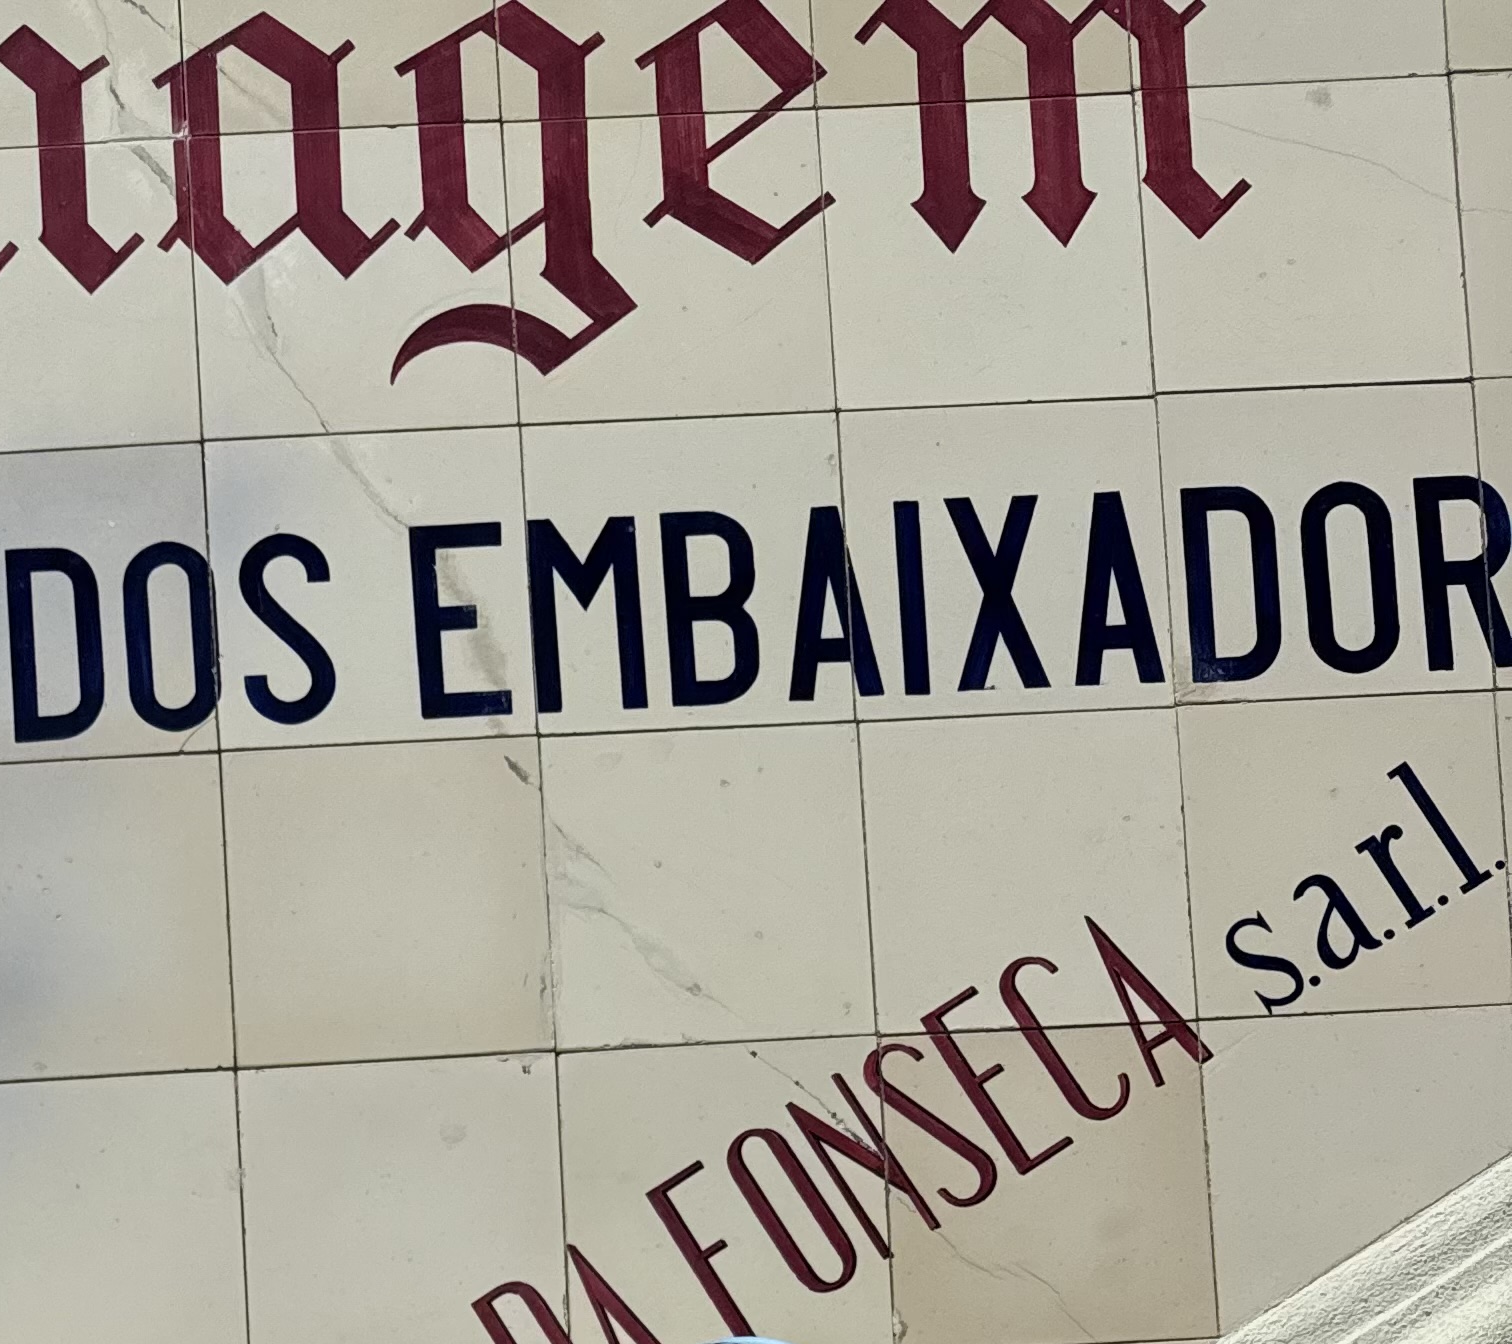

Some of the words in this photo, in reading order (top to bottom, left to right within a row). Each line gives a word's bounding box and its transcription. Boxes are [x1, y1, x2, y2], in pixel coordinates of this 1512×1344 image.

[4, 531, 336, 743] DOS
[408, 474, 1512, 720] EMBAIXADOR
[645, 915, 1215, 1338] FONSECA
